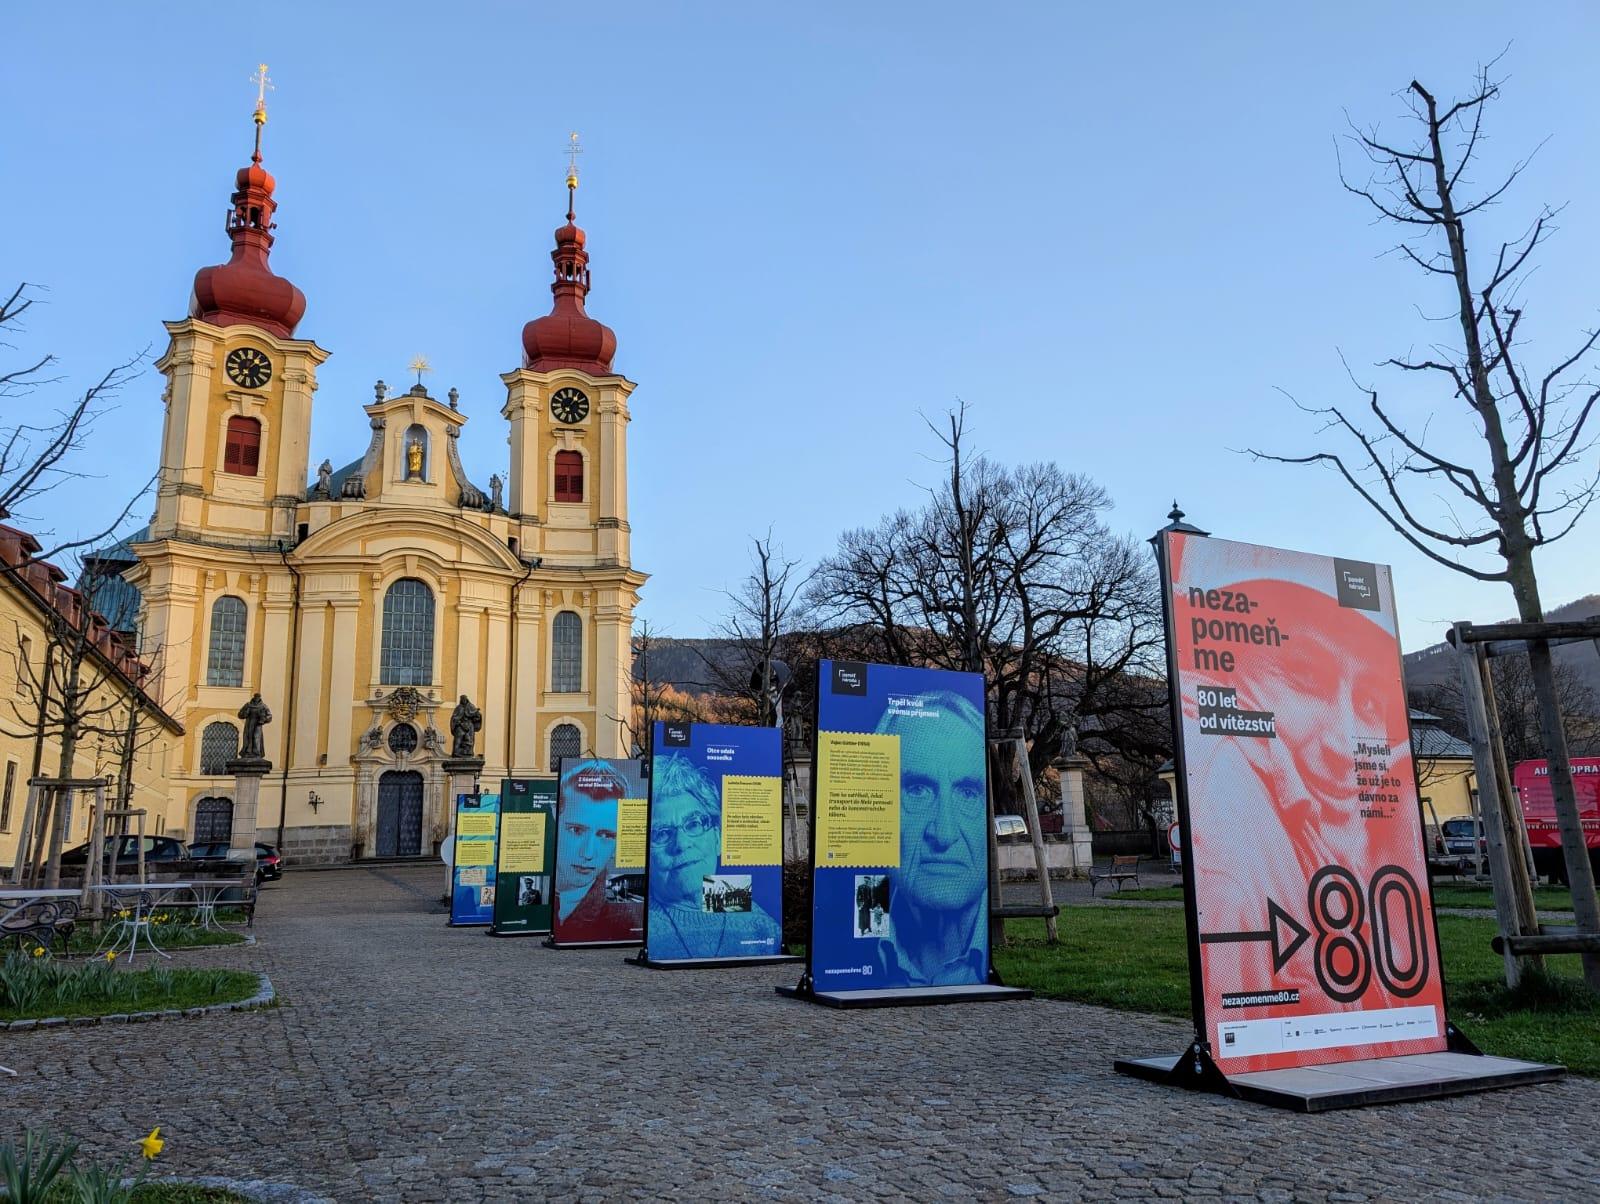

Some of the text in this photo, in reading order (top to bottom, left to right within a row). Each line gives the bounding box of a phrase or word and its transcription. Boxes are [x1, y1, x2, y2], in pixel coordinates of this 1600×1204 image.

[1188, 586, 1258, 614] neza-
[1191, 617, 1289, 647] pomeň-
[1193, 648, 1235, 672] me
[1198, 690, 1238, 709] 80 let
[1200, 714, 1276, 733] od vítězství
[1354, 758, 1390, 773] jsme si,
[1356, 774, 1401, 789] že už je to
[1358, 791, 1399, 803] dávno za
[1308, 864, 1430, 1003] 80
[862, 965, 873, 975] 80
[1222, 991, 1300, 1007] nezapomenme80.cz
